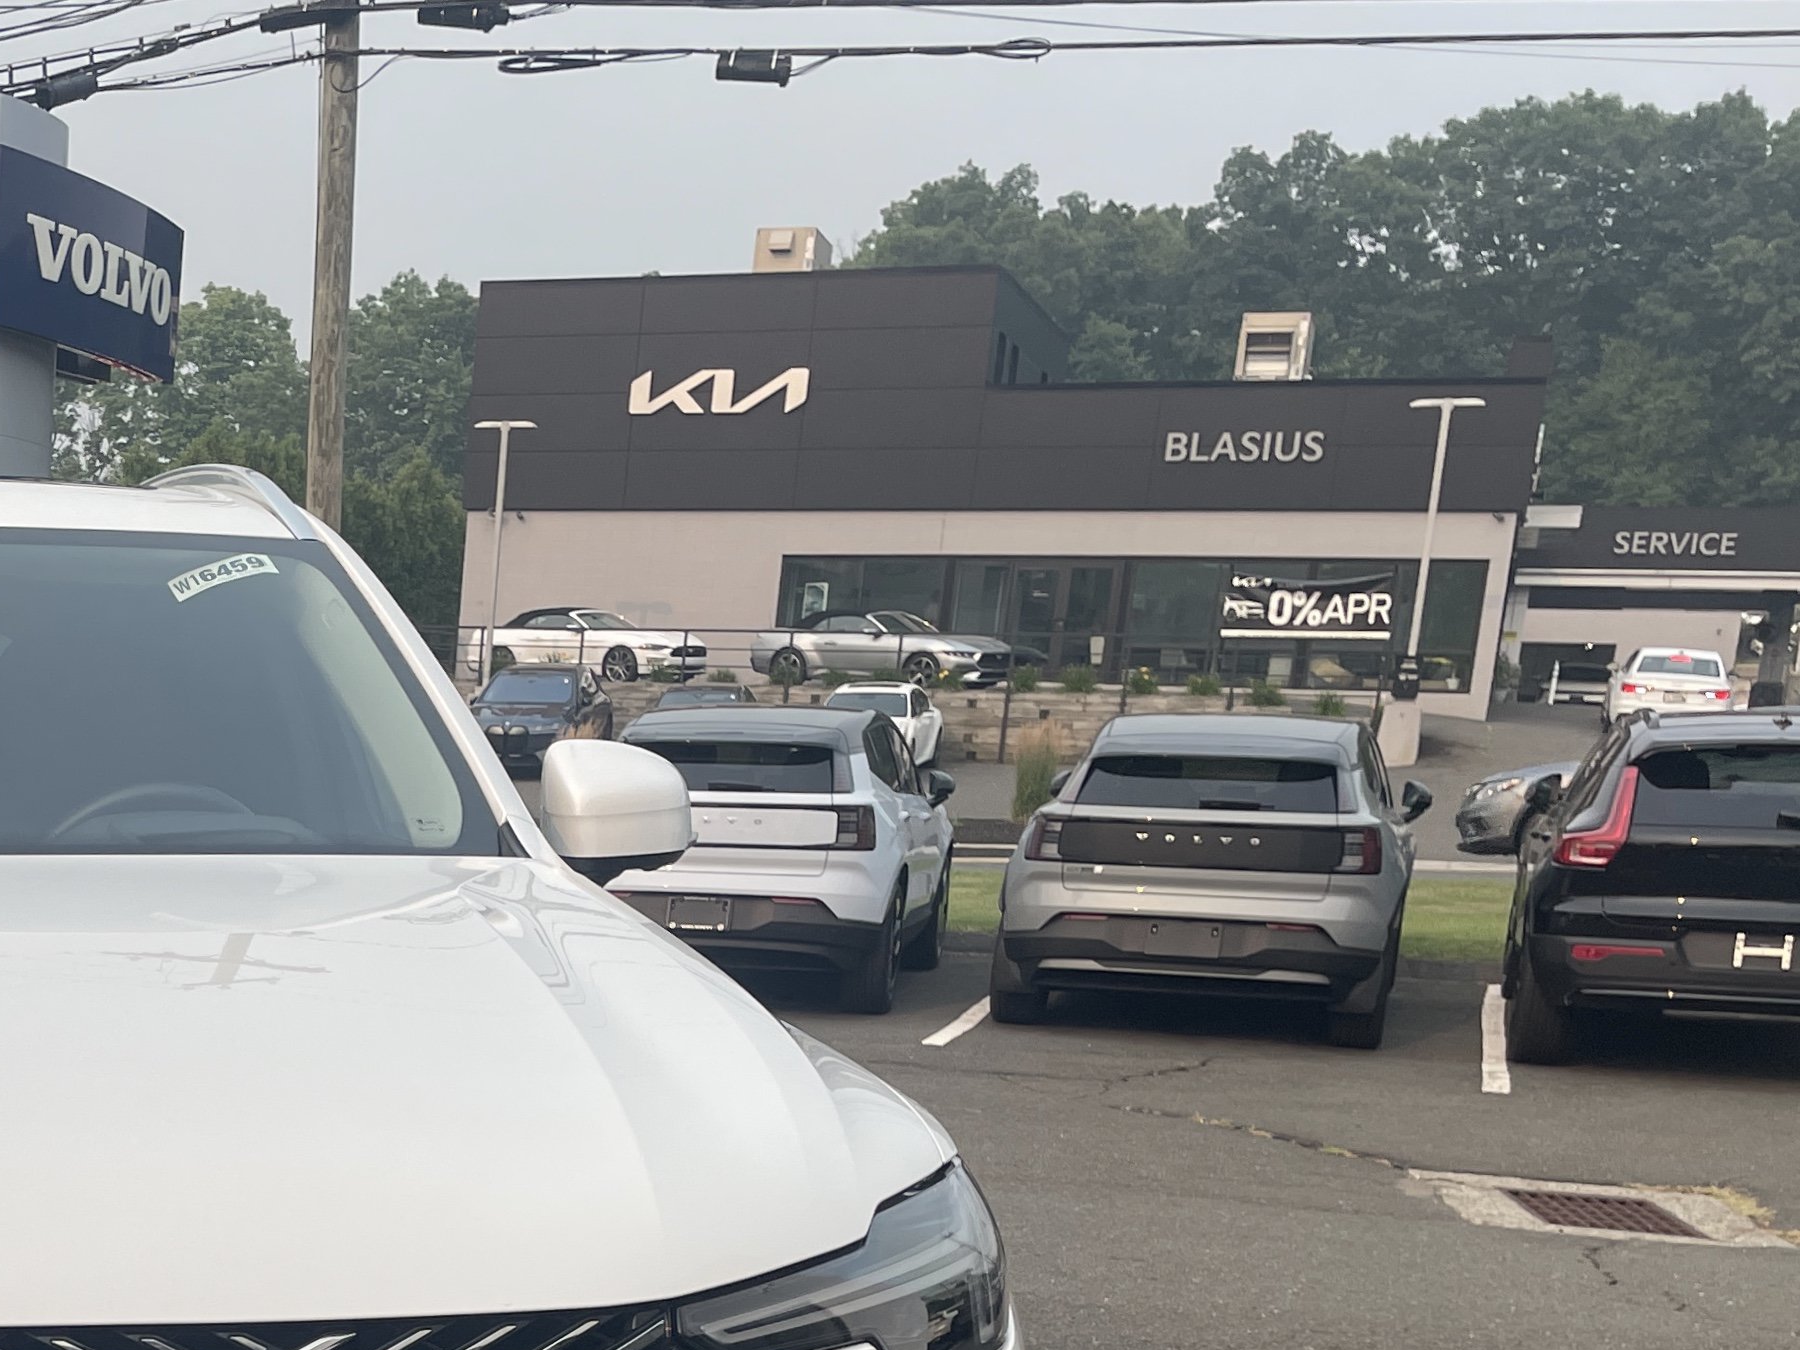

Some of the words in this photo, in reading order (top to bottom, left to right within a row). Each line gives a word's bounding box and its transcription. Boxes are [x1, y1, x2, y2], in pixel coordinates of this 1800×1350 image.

[26, 212, 172, 326] VOLVO
[628, 367, 810, 414] KIA
[1164, 430, 1325, 462] BLASIUS
[1613, 531, 1738, 556] SERVICE
[173, 556, 265, 594] W16459
